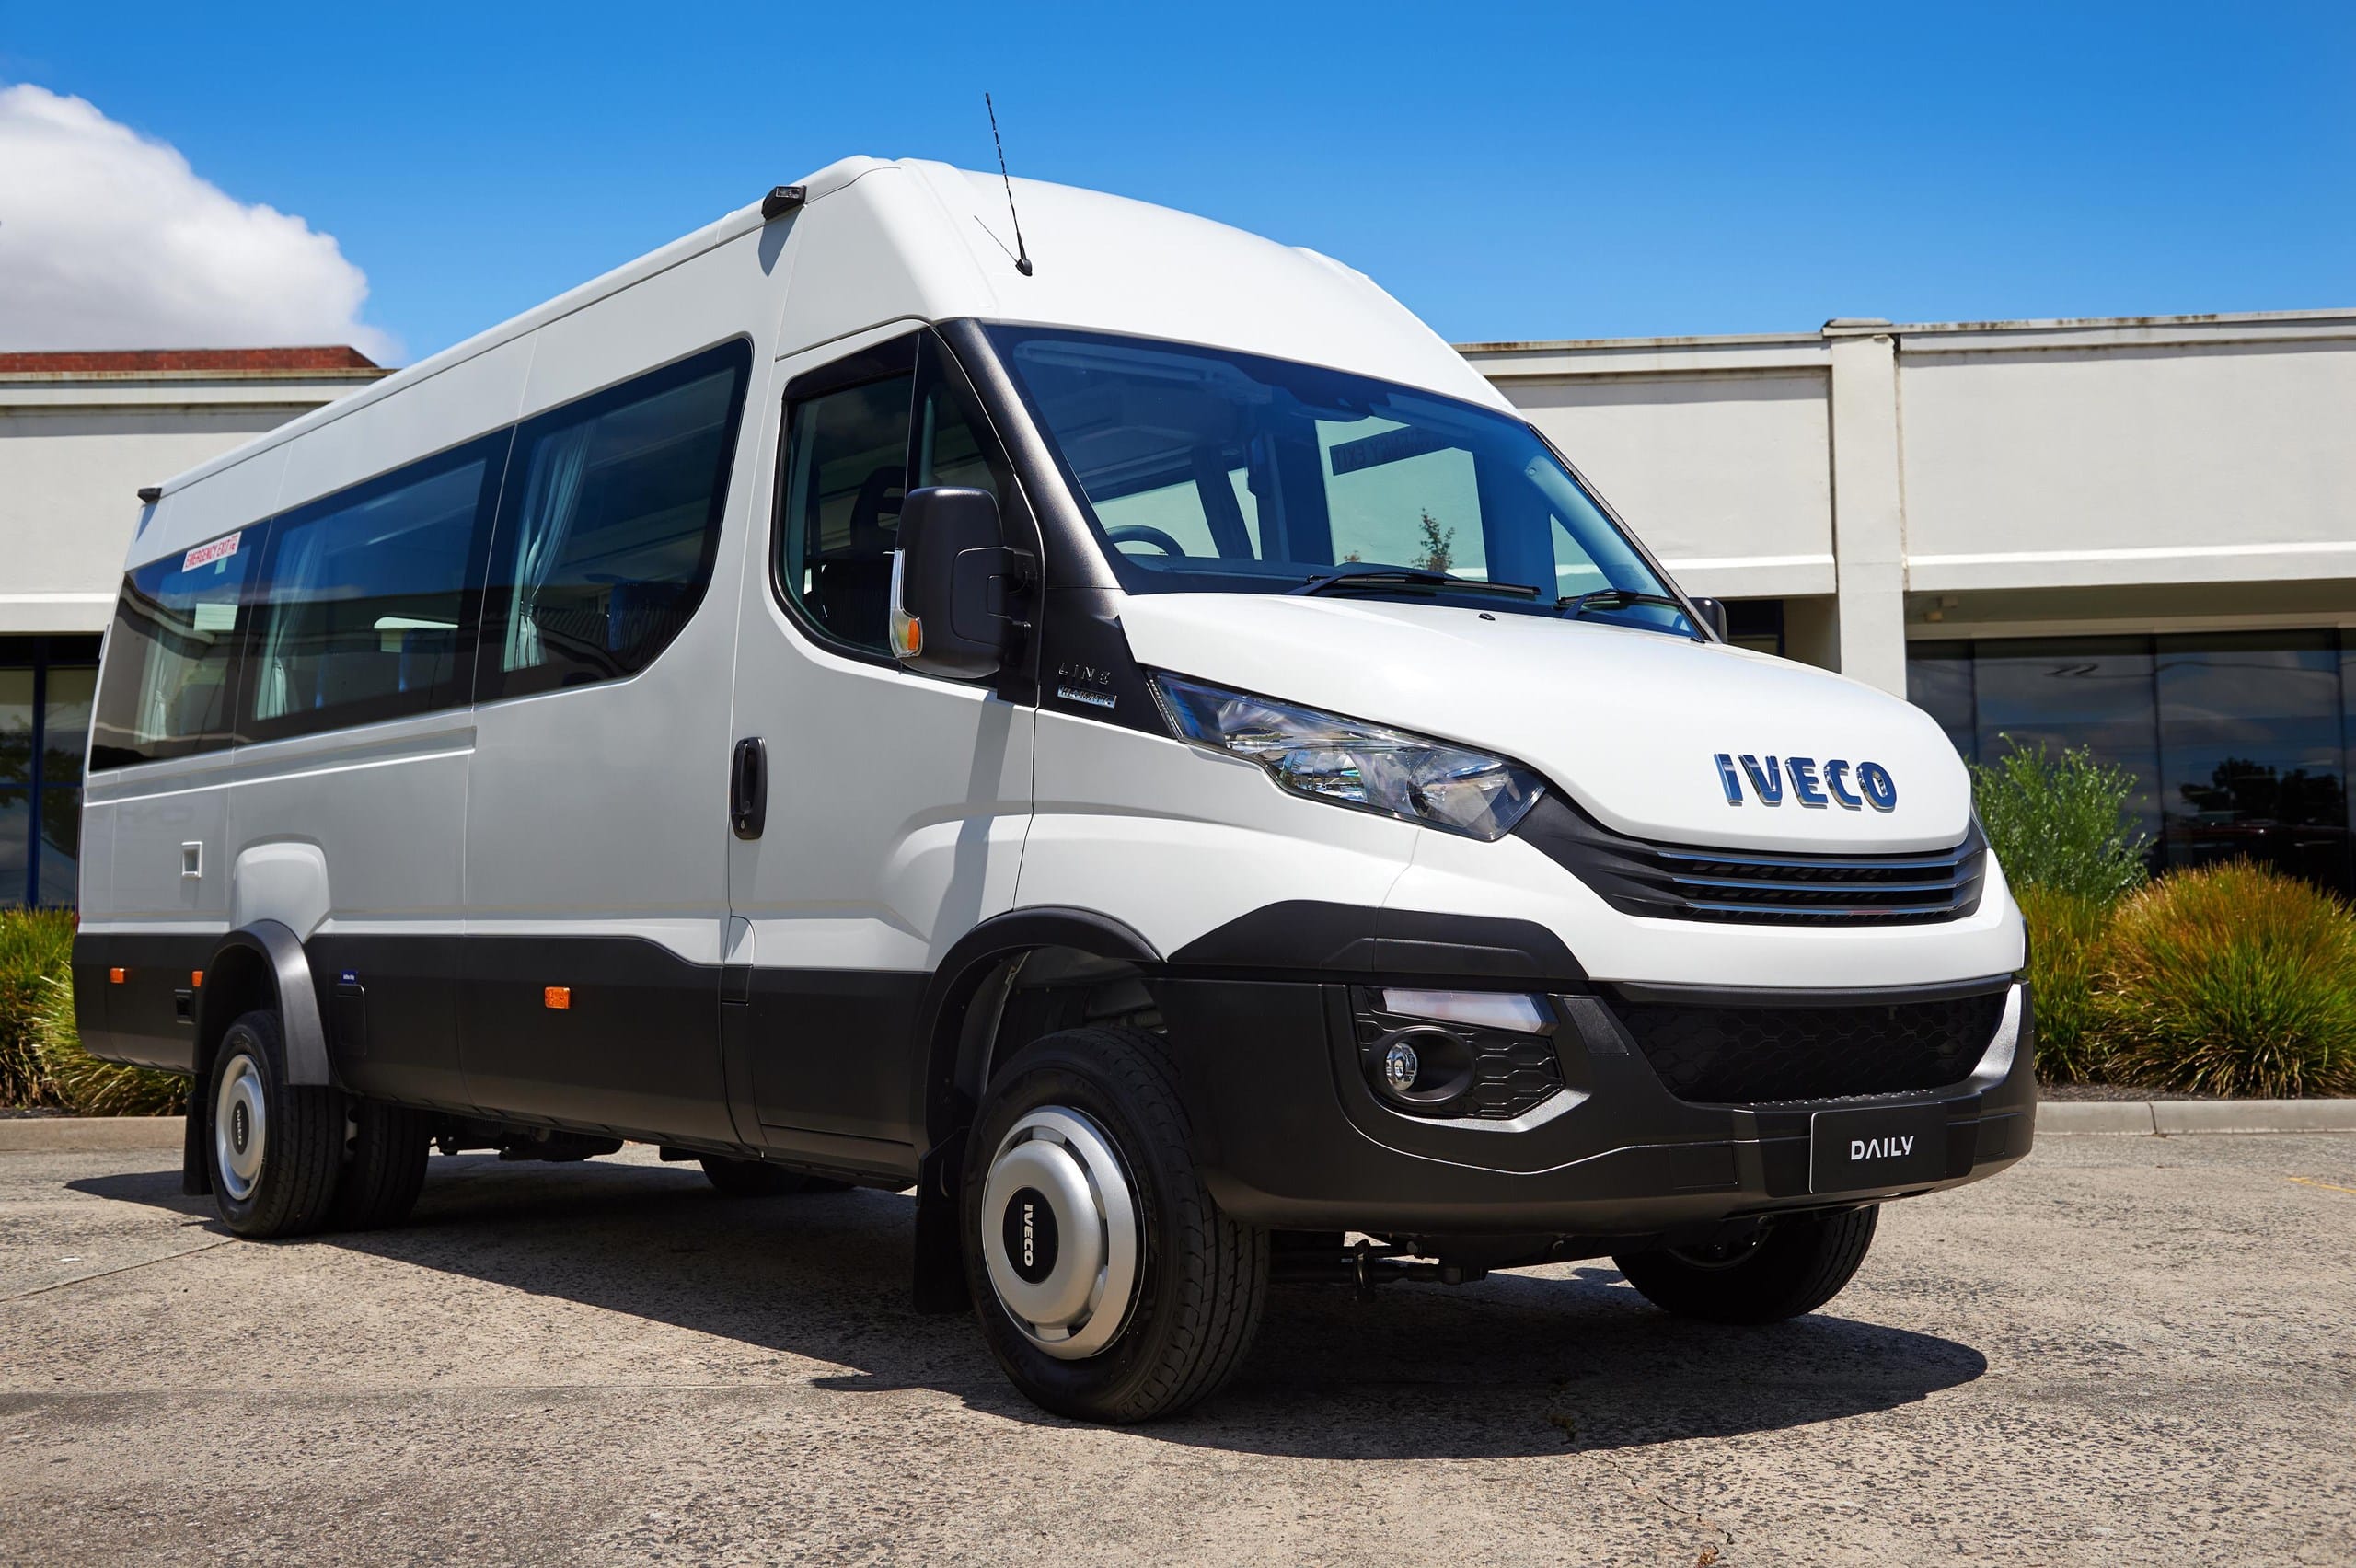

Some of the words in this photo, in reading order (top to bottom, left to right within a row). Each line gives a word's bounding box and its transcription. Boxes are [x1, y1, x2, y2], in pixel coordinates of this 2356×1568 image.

[185, 544, 217, 568] EMERGENCY
[216, 539, 230, 557] EXIT
[1714, 753, 1898, 812] IVECO
[1851, 1136, 1914, 1160] DAILY
[1024, 1204, 1034, 1267] IVECO
